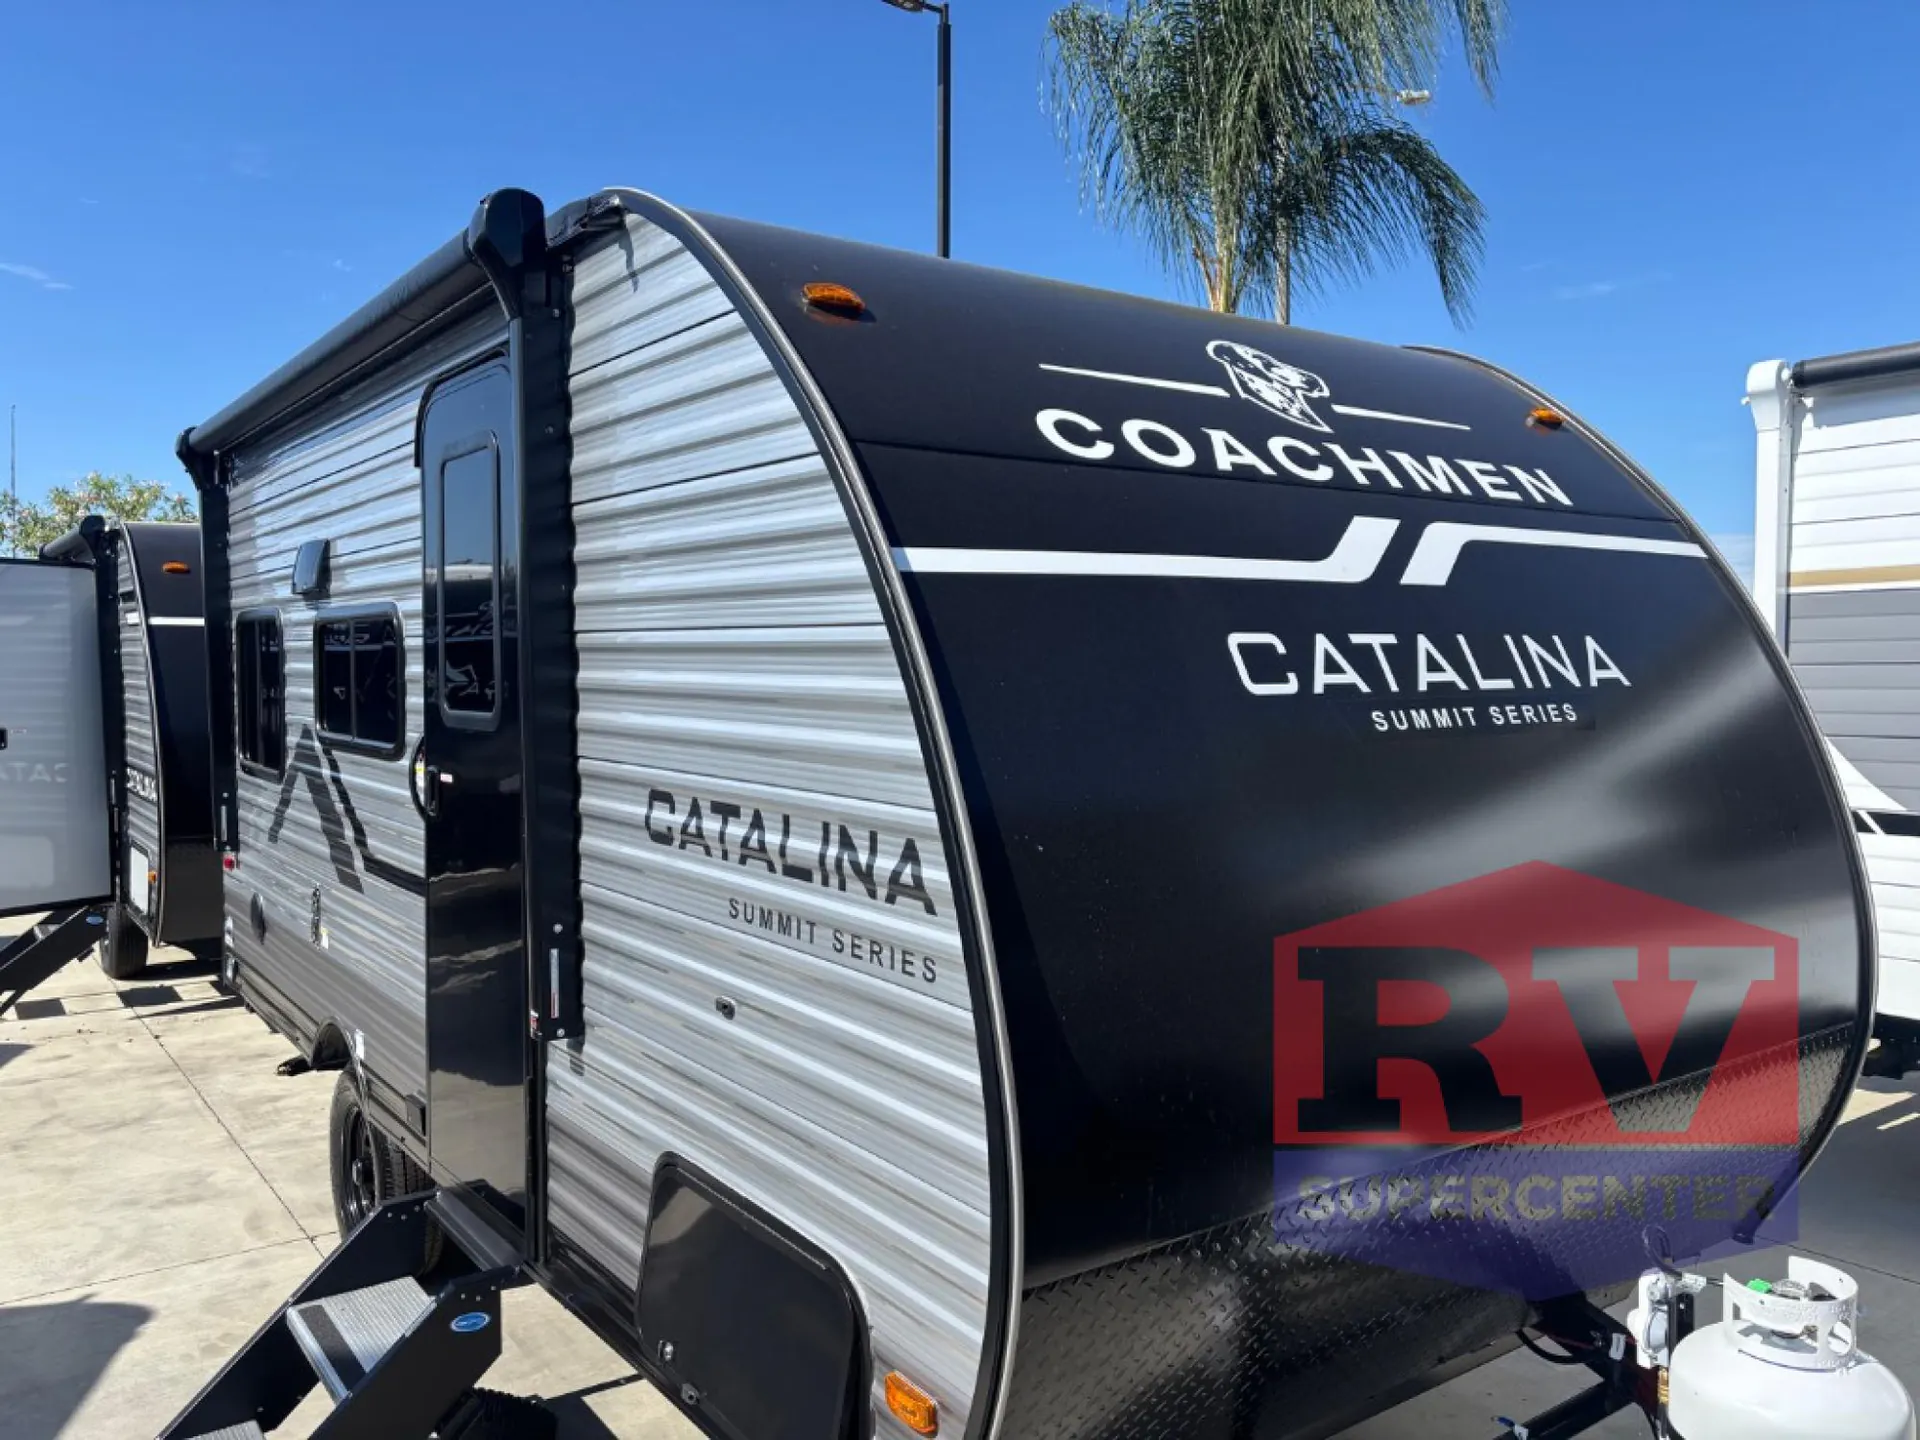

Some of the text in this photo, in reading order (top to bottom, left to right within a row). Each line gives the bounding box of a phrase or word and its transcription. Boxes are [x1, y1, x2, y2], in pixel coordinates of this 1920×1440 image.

[1036, 408, 1573, 506] COACHMEN
[1227, 632, 1631, 695] CATALINA
[1371, 702, 1578, 731] SUMMIT SERIES
[645, 789, 938, 917] CATALINA
[729, 897, 938, 984] SUMMIT SERIES
